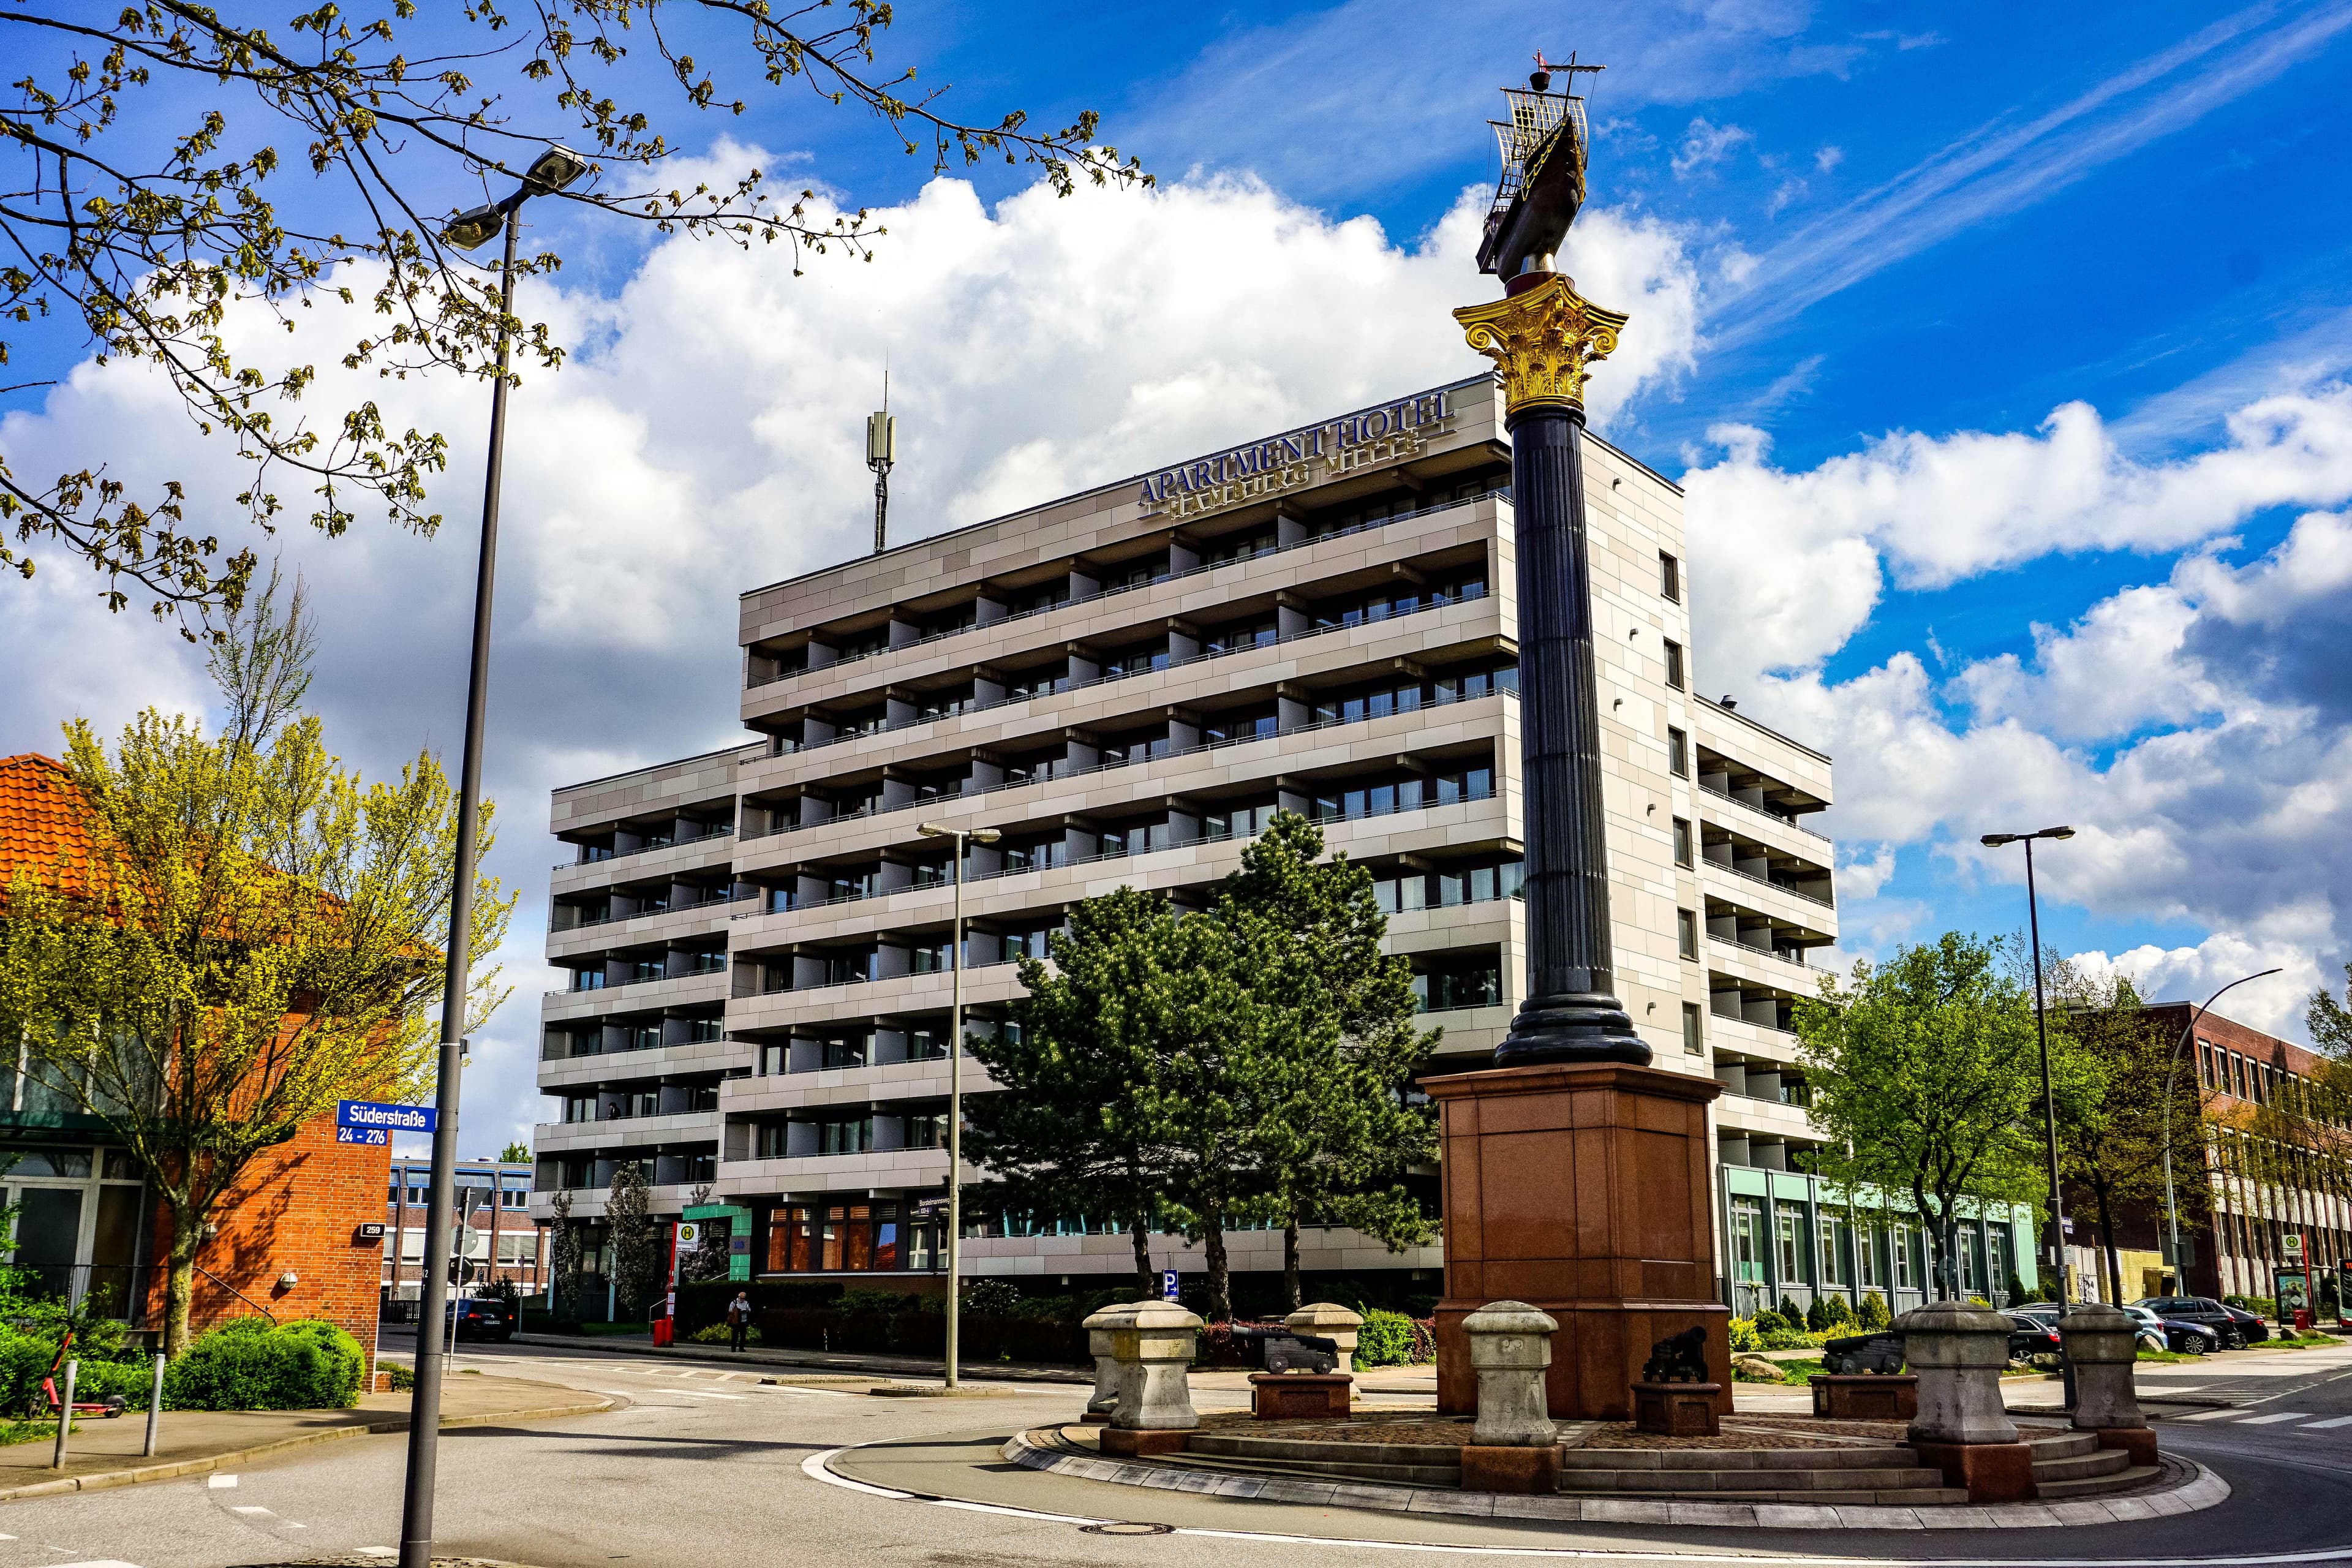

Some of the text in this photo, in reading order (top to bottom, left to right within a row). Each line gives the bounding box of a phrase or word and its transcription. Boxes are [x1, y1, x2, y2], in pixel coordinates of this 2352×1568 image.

[1137, 391, 1457, 506] APARTMENT HOTEL
[1170, 429, 1419, 519] HAMBURG MITTE
[349, 1105, 426, 1127] Süderstraße
[339, 1127, 353, 1142] 24
[366, 1129, 385, 1144] 276
[919, 1197, 950, 1207] Borstelmannsweg
[684, 1229, 691, 1237] H
[1165, 1273, 1176, 1292] P
